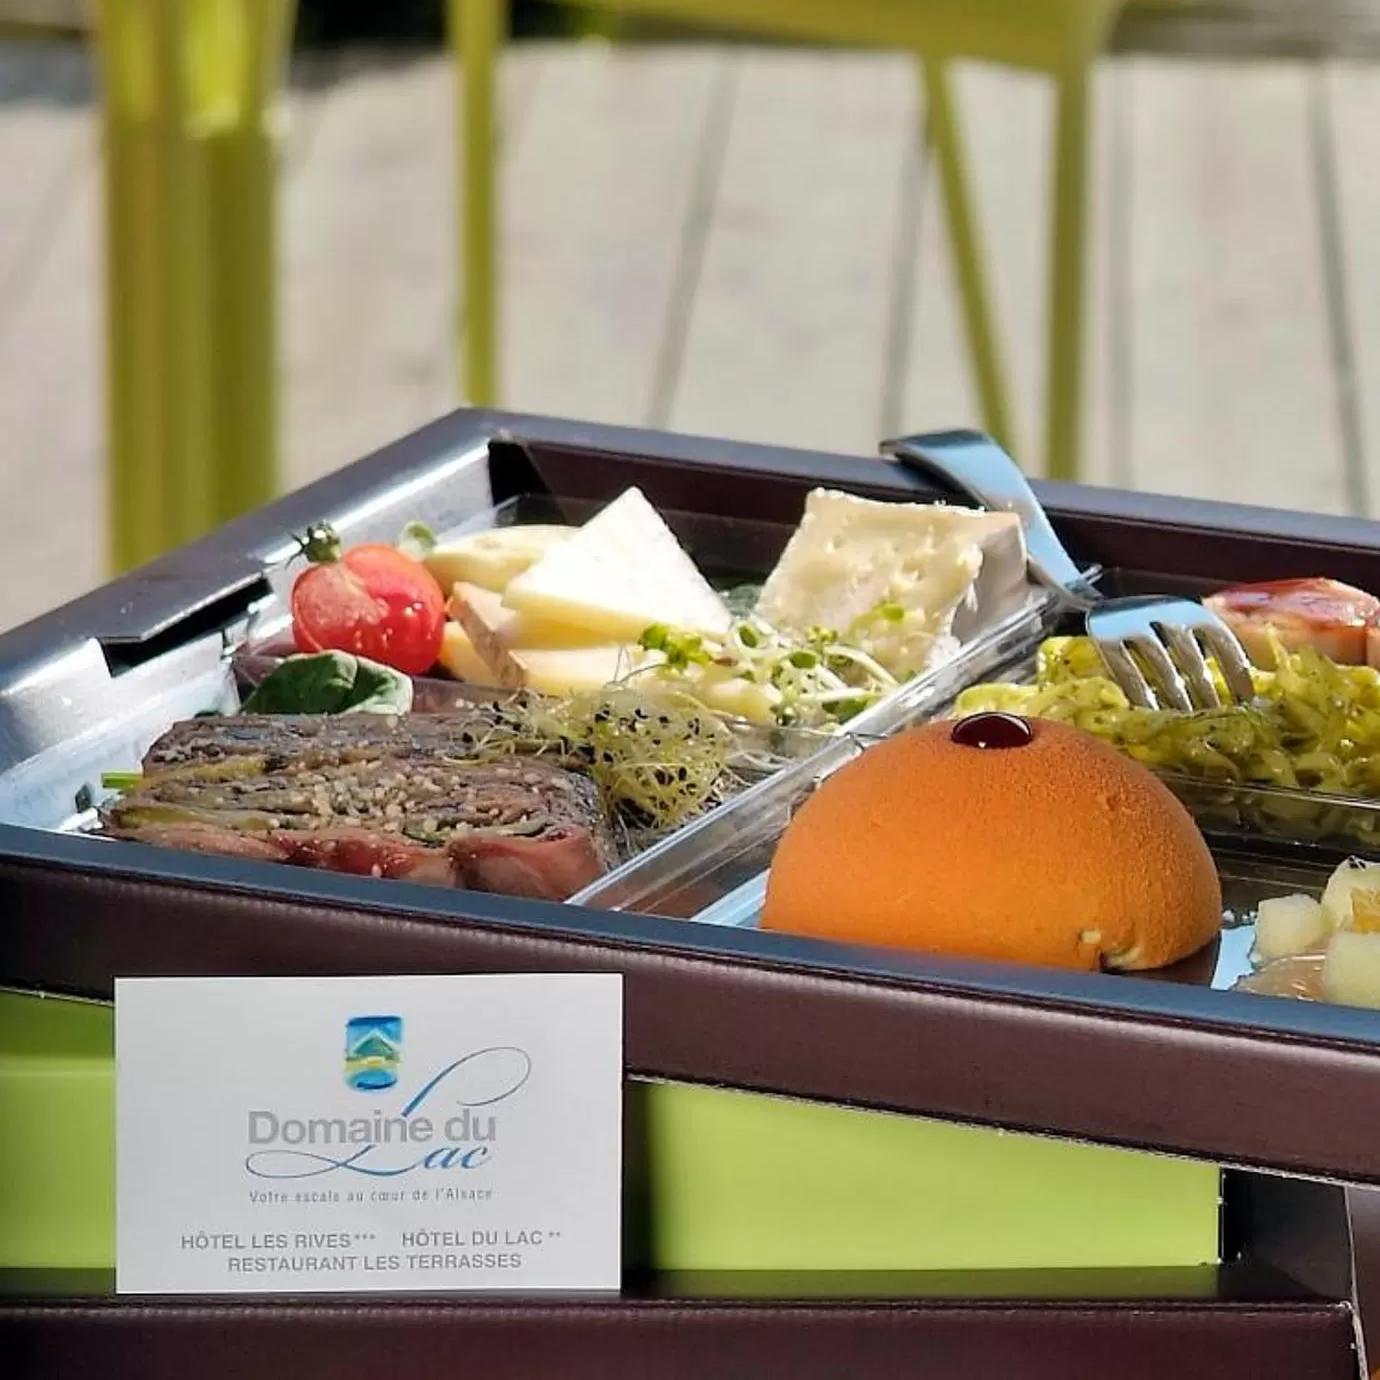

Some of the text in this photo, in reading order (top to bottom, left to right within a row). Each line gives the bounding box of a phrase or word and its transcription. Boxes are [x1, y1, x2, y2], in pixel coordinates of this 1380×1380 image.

[248, 1108, 496, 1144] Domaine du
[249, 1191, 288, 1203] Votre
[295, 1191, 340, 1202] escale
[347, 1192, 364, 1202] au
[412, 1189, 429, 1201] de
[251, 1233, 288, 1249] LES
[472, 1230, 498, 1246] DU
[227, 1253, 522, 1272] RESTAURANT LES TERRASSES
